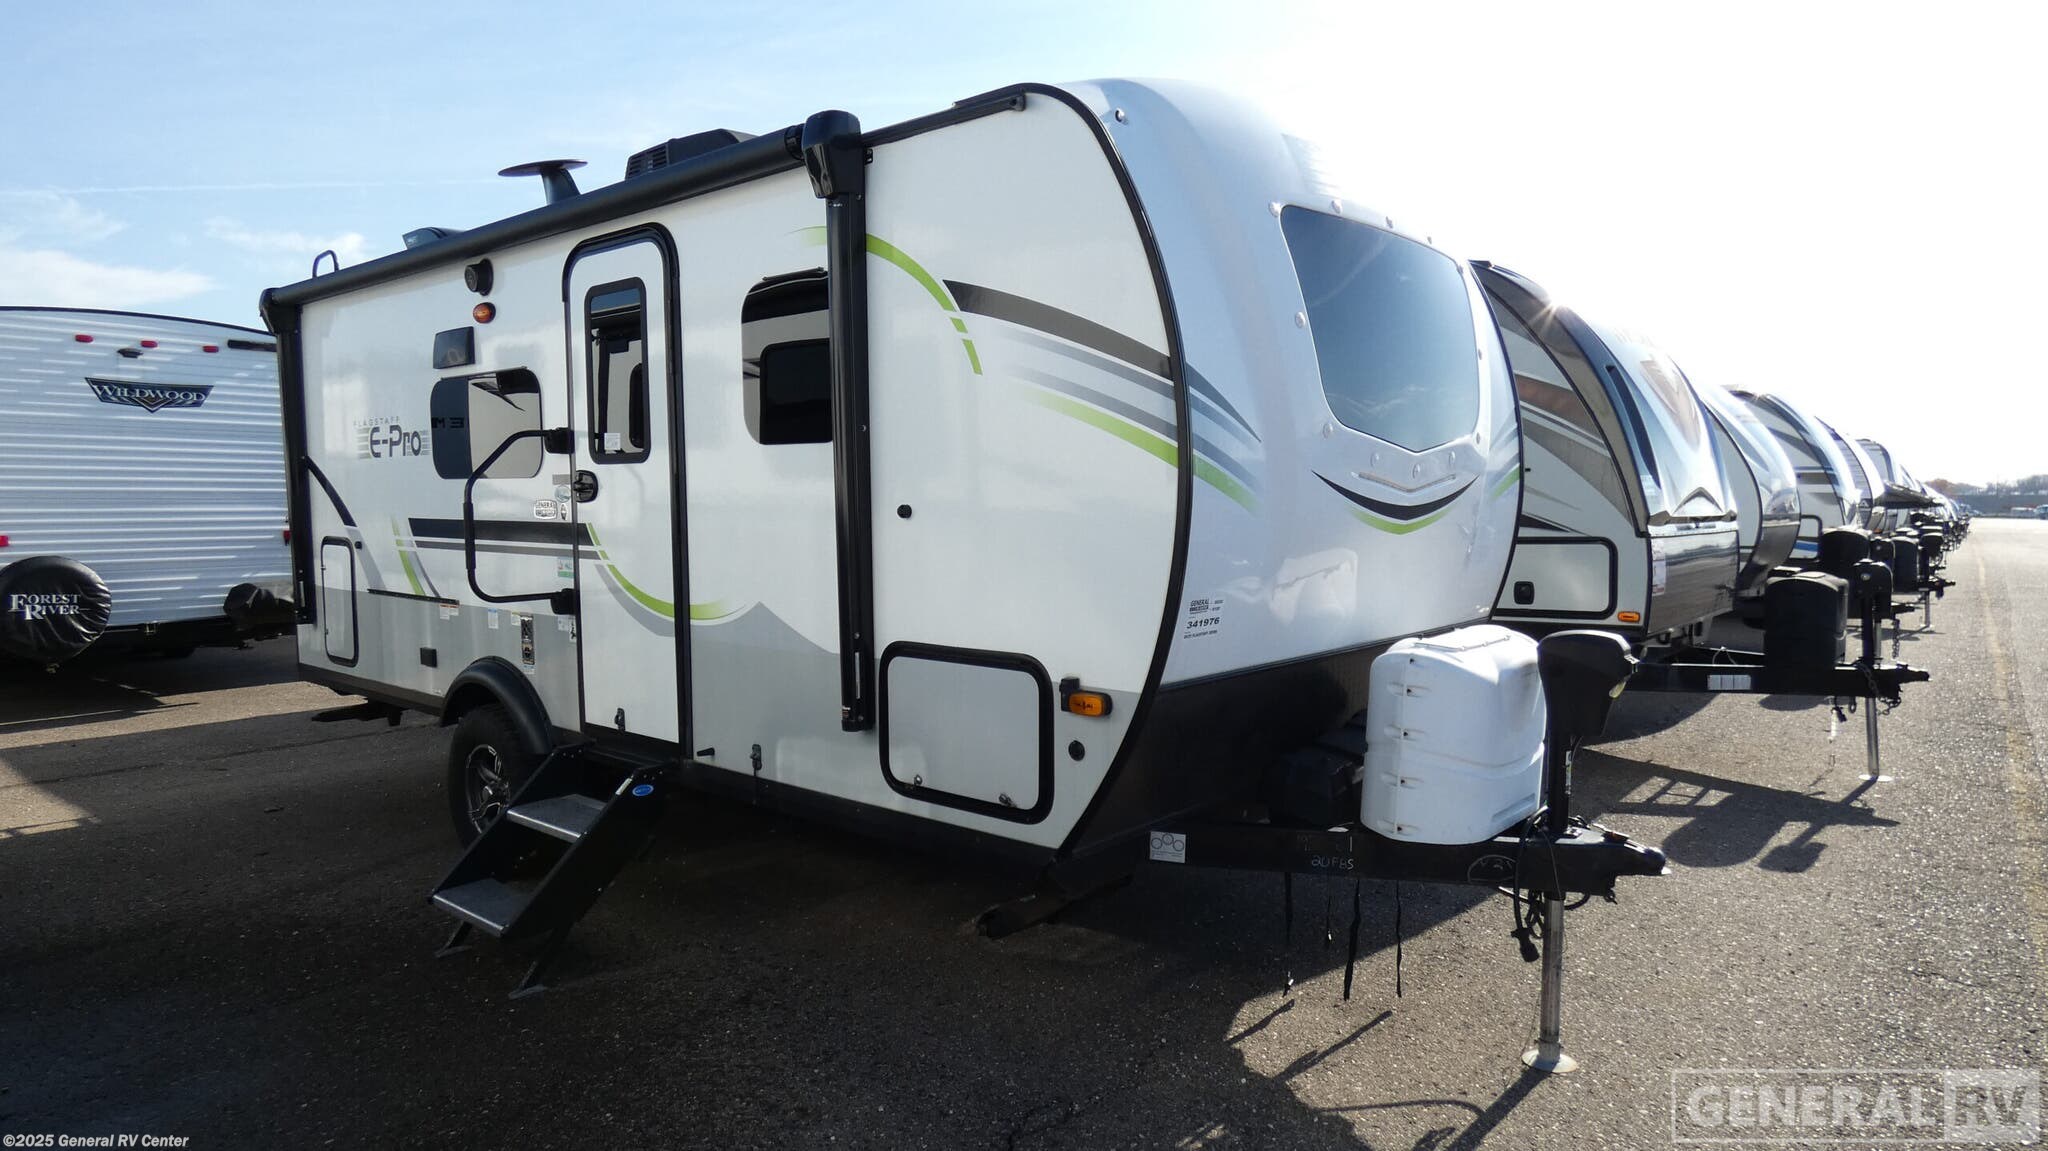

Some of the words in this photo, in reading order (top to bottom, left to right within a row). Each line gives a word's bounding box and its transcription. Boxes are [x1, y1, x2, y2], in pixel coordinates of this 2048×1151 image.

[92, 384, 206, 401] WILDWOOD
[353, 416, 400, 427] FLAGSTAFF
[369, 424, 422, 459] E-Pro
[9, 593, 81, 612] FOREST
[24, 604, 80, 620] RIVER
[1186, 616, 1220, 629] 341976
